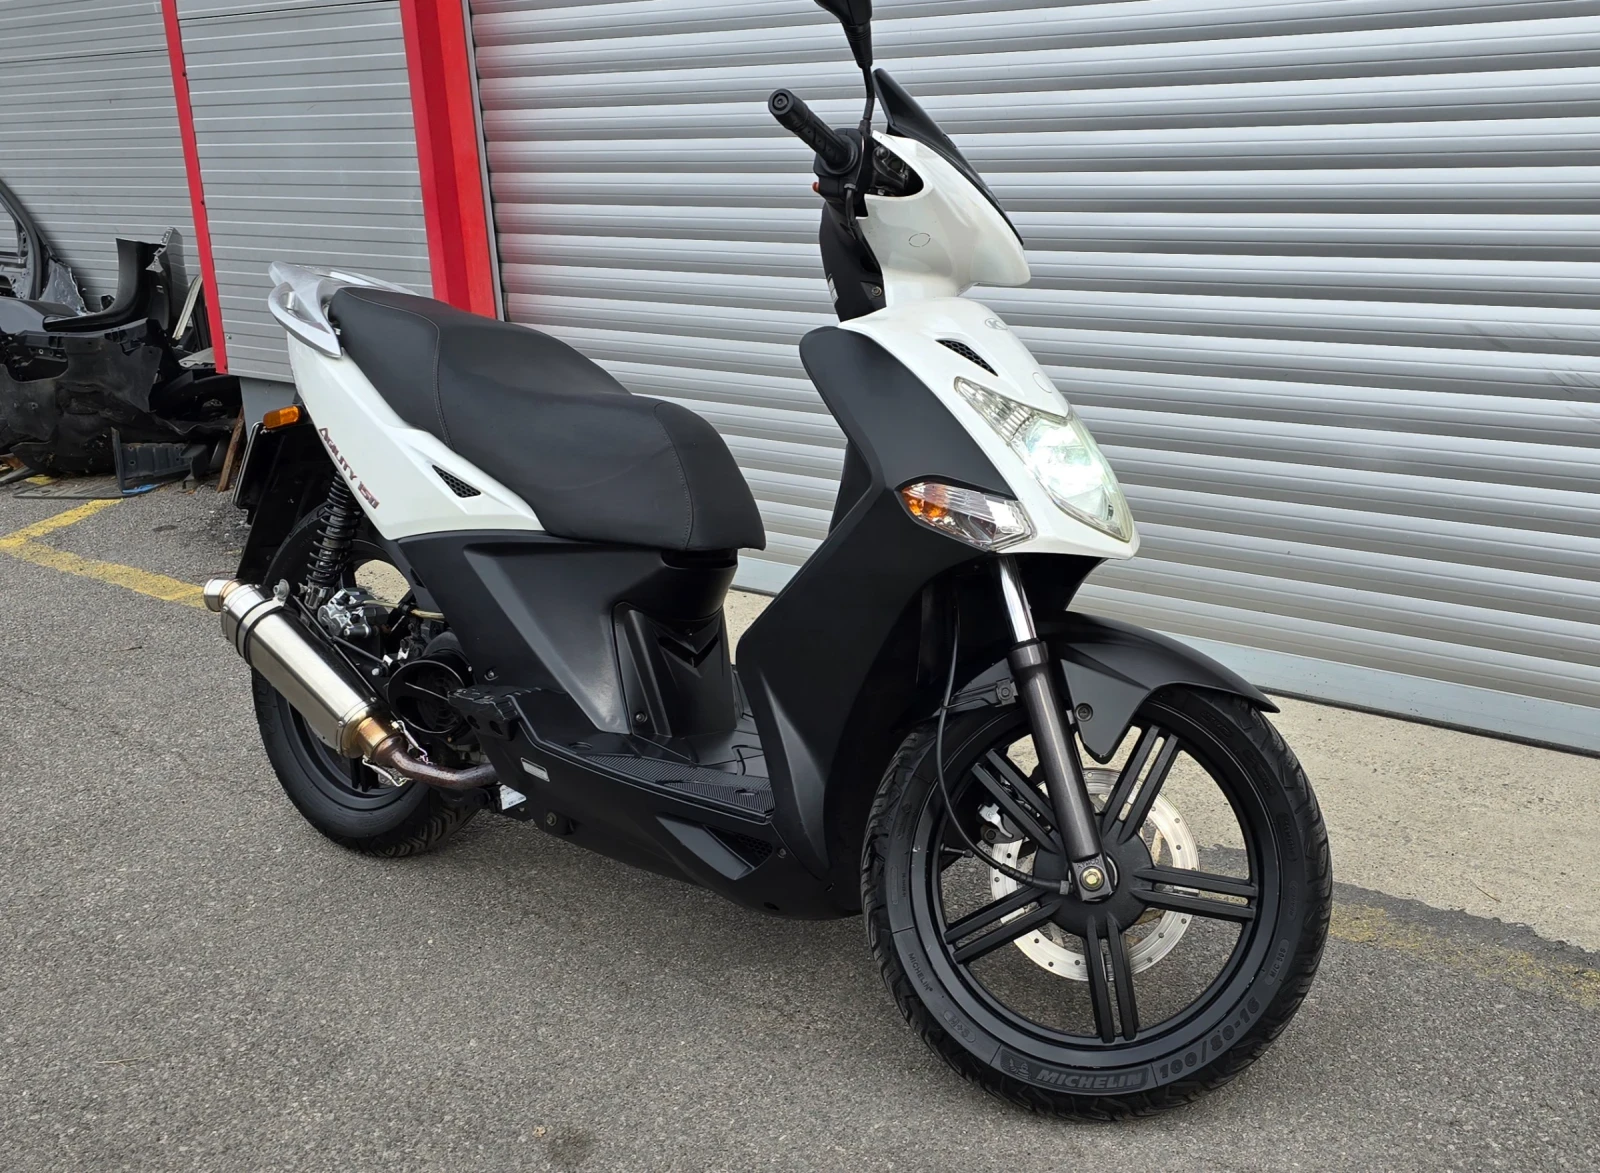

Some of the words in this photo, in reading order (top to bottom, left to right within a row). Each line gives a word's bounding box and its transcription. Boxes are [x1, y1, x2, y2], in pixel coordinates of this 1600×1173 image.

[358, 481, 380, 509] 150
[1158, 996, 1260, 1079] 100/80-16
[1035, 1068, 1143, 1090] MICHELIN
